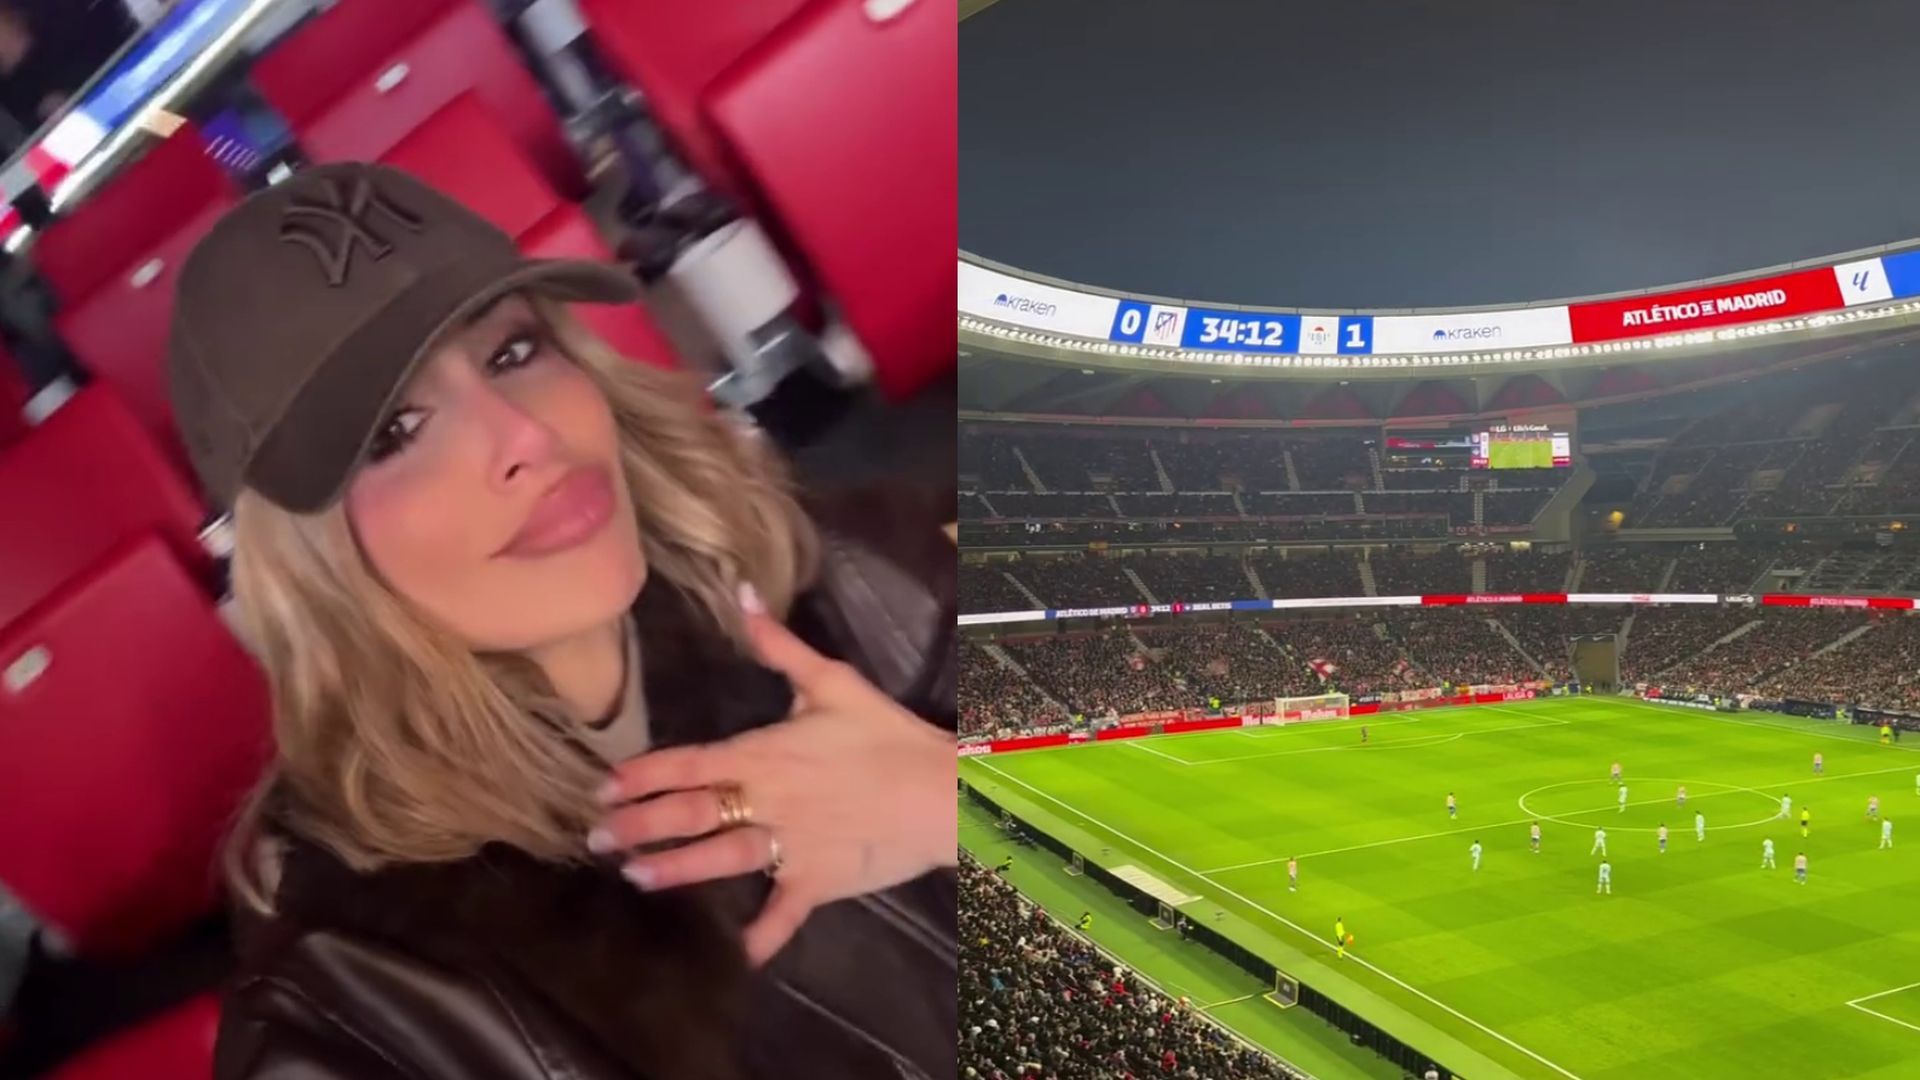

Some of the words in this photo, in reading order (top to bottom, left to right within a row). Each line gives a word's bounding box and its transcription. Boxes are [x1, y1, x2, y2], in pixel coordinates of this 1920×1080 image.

[1006, 294, 1056, 317] kraken
[1622, 302, 1700, 327] ATLÉTICO
[1701, 300, 1715, 316] DE
[1716, 289, 1786, 314] MADRID
[1121, 309, 1141, 336] 0
[1200, 317, 1283, 346] 34:12
[1448, 324, 1501, 340] kraken
[1346, 324, 1366, 348] 1
